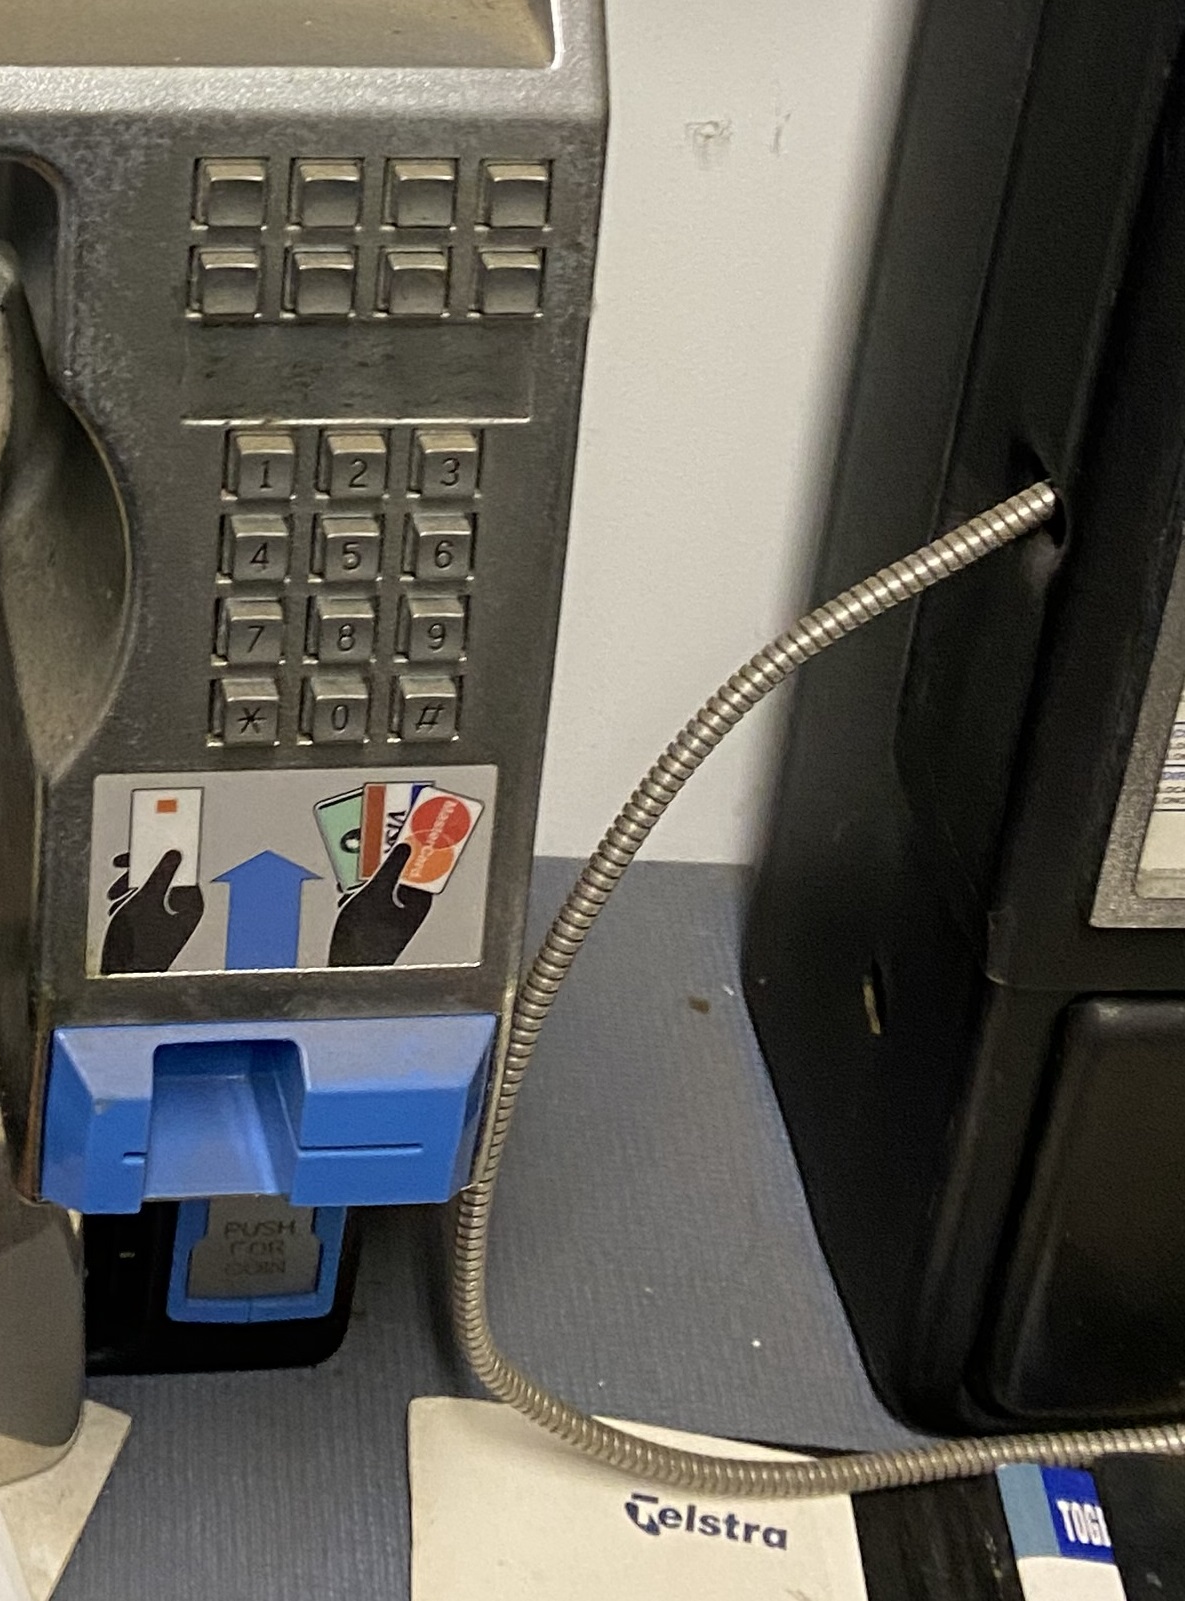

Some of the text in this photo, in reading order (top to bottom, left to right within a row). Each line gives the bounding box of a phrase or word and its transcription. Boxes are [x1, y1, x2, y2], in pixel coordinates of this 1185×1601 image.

[259, 457, 460, 489] 1 2 3
[249, 540, 454, 571] 4 5 6
[245, 621, 447, 653] 7 8 9
[329, 703, 349, 732] 0
[224, 1219, 296, 1239] PUSH
[624, 1492, 787, 1550] Telstra
